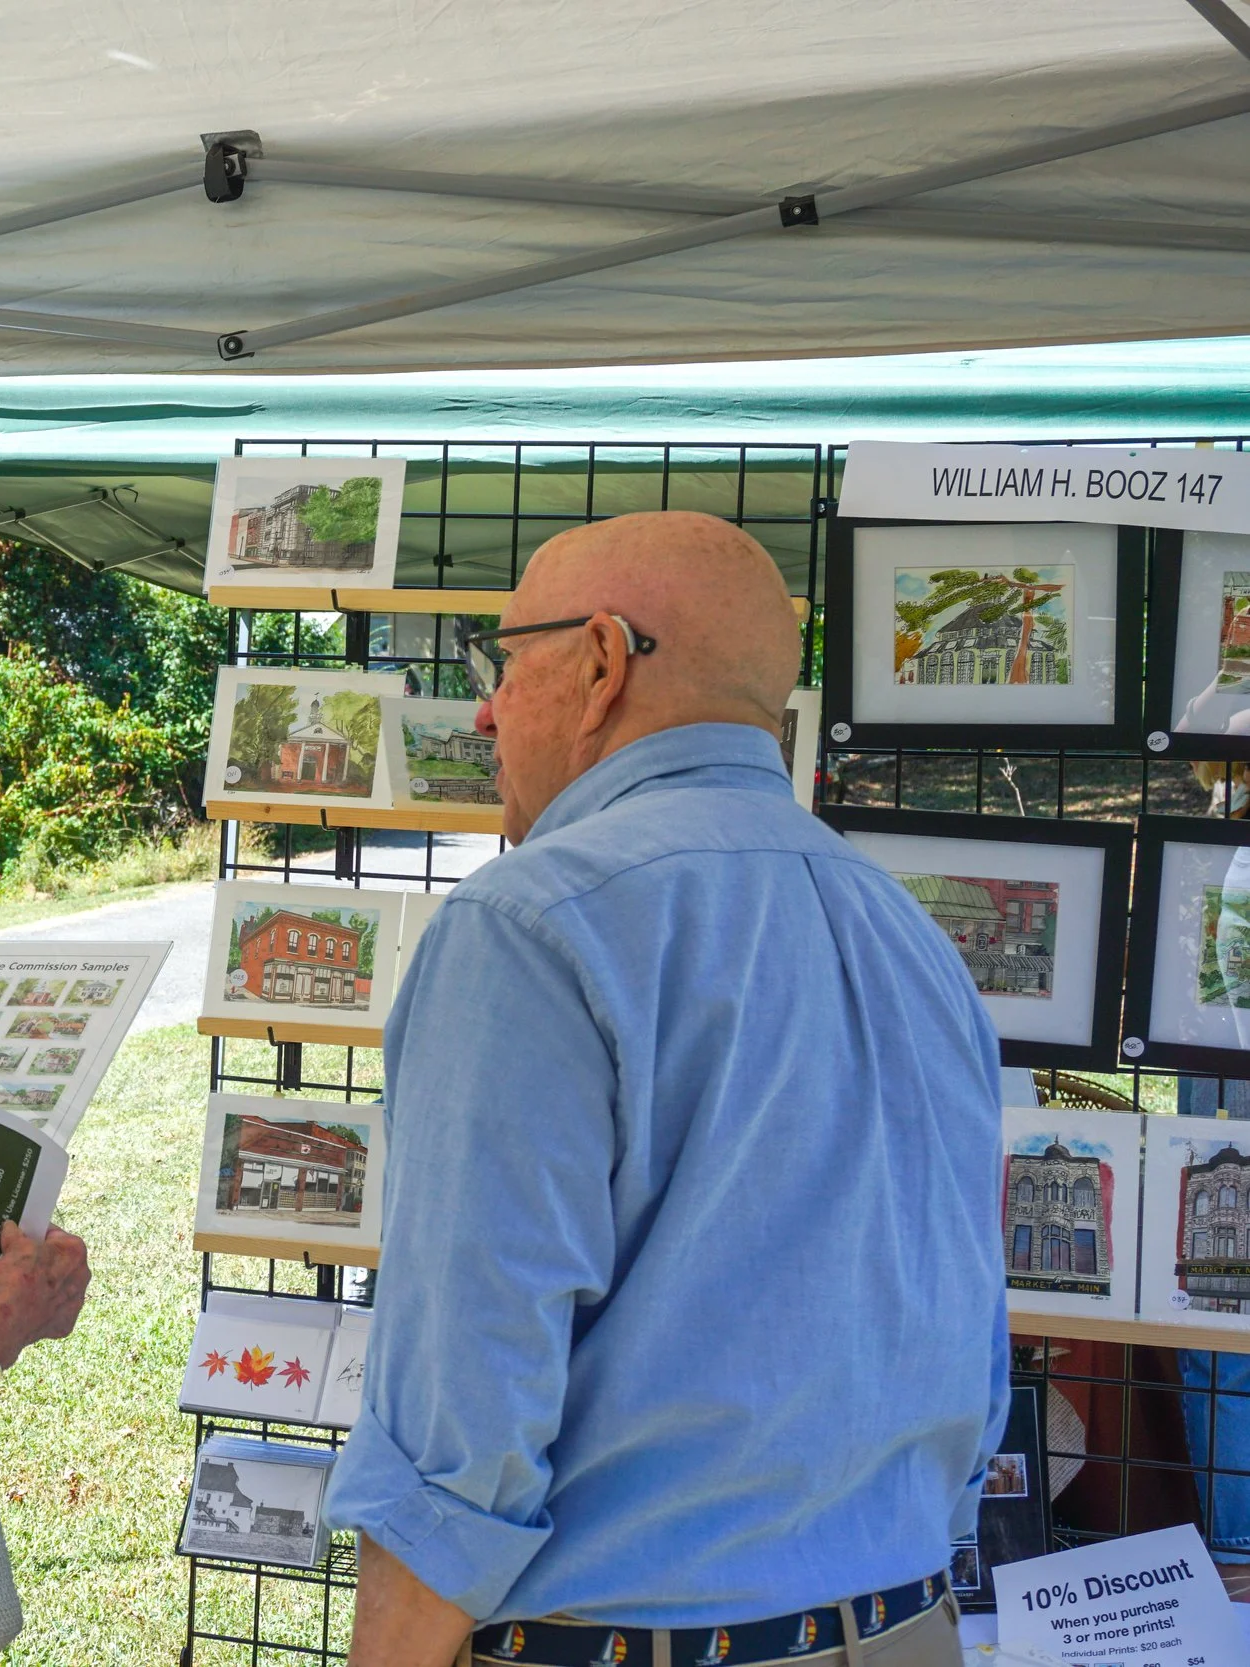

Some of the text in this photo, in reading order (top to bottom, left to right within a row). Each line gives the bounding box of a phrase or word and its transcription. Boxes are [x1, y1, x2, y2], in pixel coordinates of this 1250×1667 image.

[933, 467, 1223, 505] WILLIAM H. BOOZ 147
[9, 962, 77, 971] Commission
[80, 962, 130, 973] Samples
[6, 1199, 15, 1213] Use
[12, 1169, 26, 1198] License:
[23, 1148, 32, 1167] $250
[1011, 1279, 1053, 1289] MARKET
[1078, 1284, 1100, 1293] MAIN
[1022, 1559, 1194, 1611] 10% Discount
[1051, 1599, 1180, 1630] When you purchase
[1063, 1616, 1175, 1644] 3 or more prints!
[1061, 1638, 1182, 1658] Individual Prints: $20 each
[1187, 1656, 1205, 1666] $54
